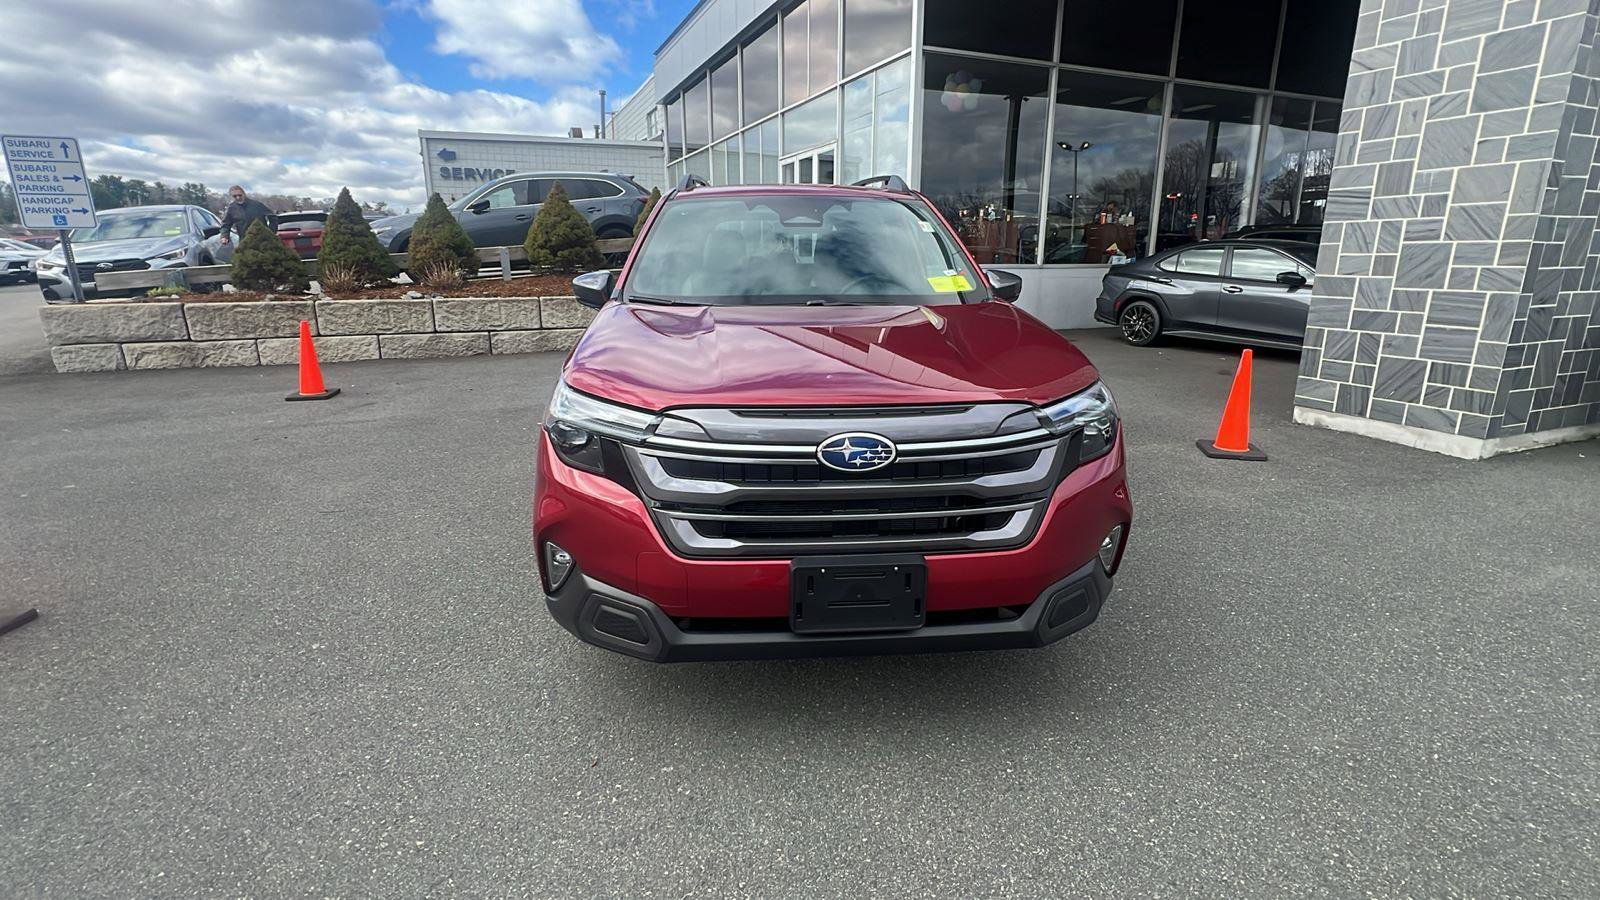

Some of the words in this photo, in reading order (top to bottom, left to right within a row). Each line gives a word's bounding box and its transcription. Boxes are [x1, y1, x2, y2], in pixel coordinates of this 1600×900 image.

[7, 140, 50, 148] SUBARU
[10, 150, 54, 158] SERVICE
[14, 164, 57, 172] SUBARU
[16, 174, 49, 182] SALES
[19, 184, 64, 192] PARKING
[22, 197, 74, 205] HANDICAP
